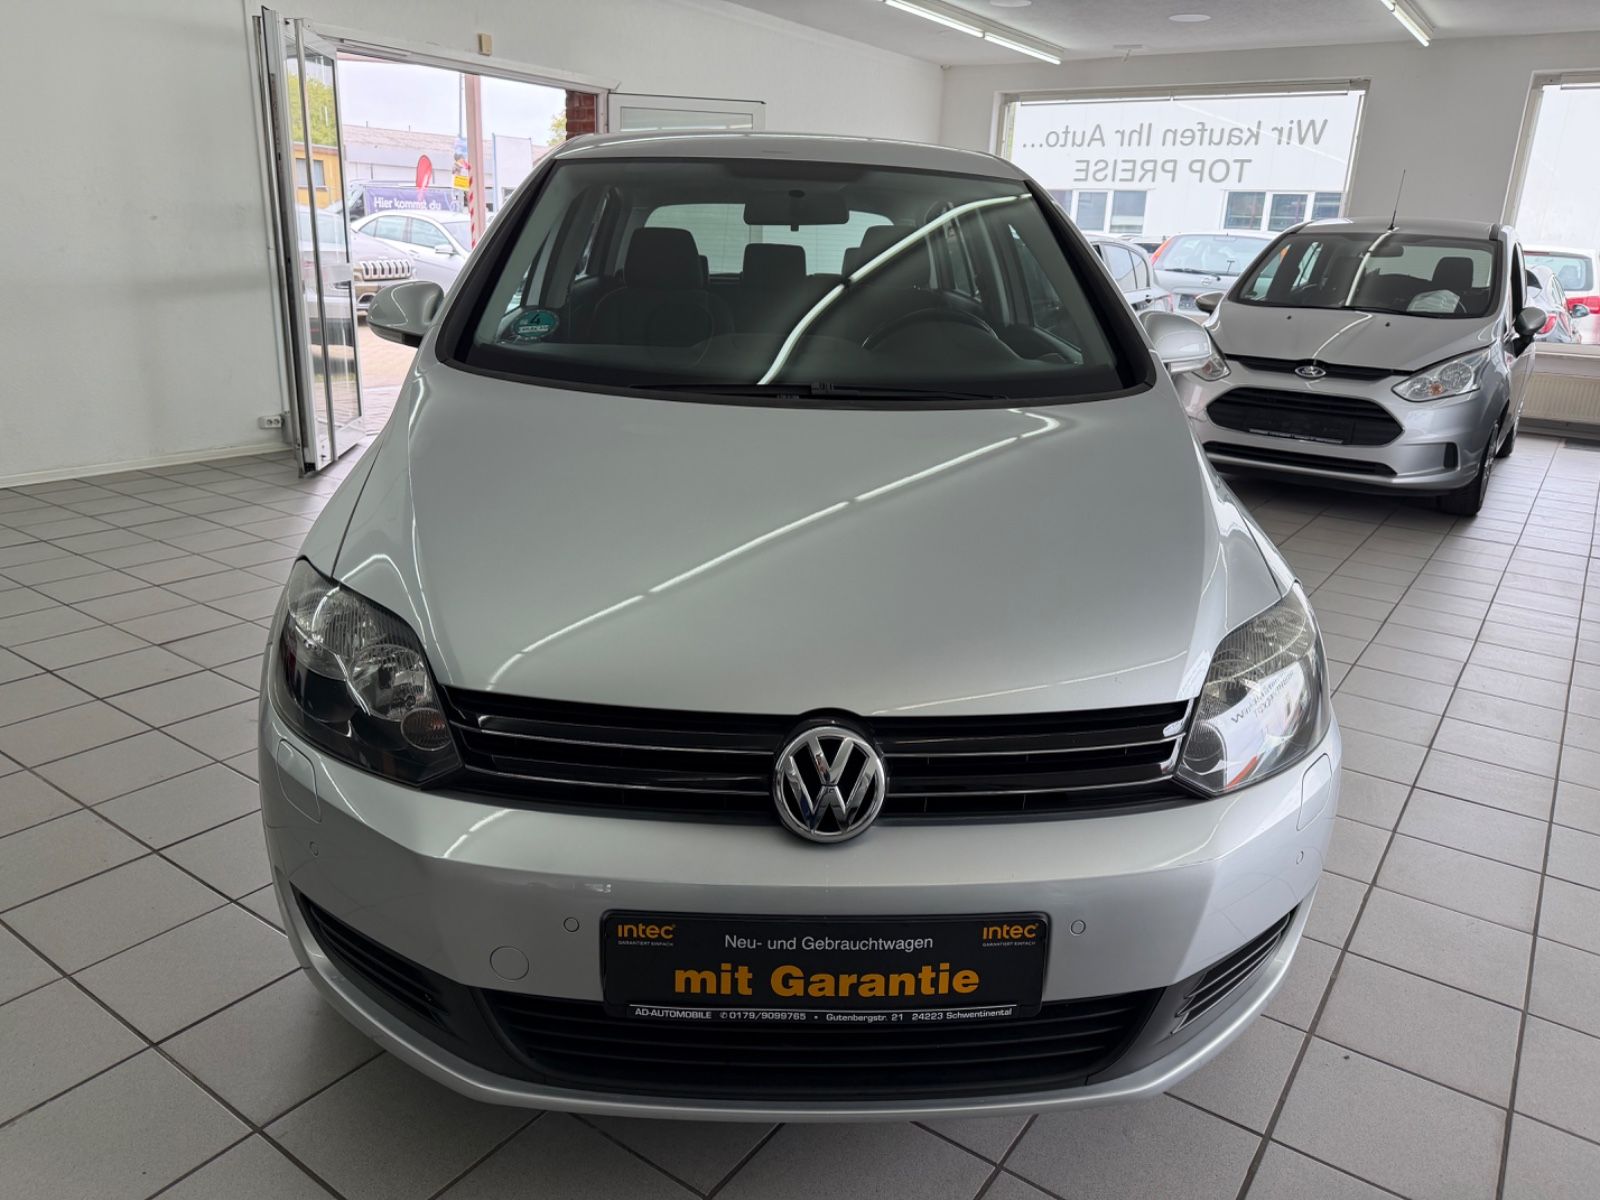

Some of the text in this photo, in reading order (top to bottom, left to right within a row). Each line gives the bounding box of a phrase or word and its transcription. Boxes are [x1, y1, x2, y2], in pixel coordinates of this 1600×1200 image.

[374, 196, 392, 209] Hier
[429, 199, 441, 209] du
[529, 314, 541, 326] 4
[617, 923, 674, 939] intec
[982, 923, 1037, 940] intec
[724, 934, 933, 953] Neu- und Gebrauchtwagen
[674, 963, 980, 997] mit Garantie
[635, 1008, 712, 1019] AD-AUTOMOBILE
[826, 1013, 887, 1023] Gutenbergstr.
[891, 1013, 904, 1021] 21
[911, 1012, 944, 1020] 24223
[946, 1008, 1012, 1020] Schwentinental
